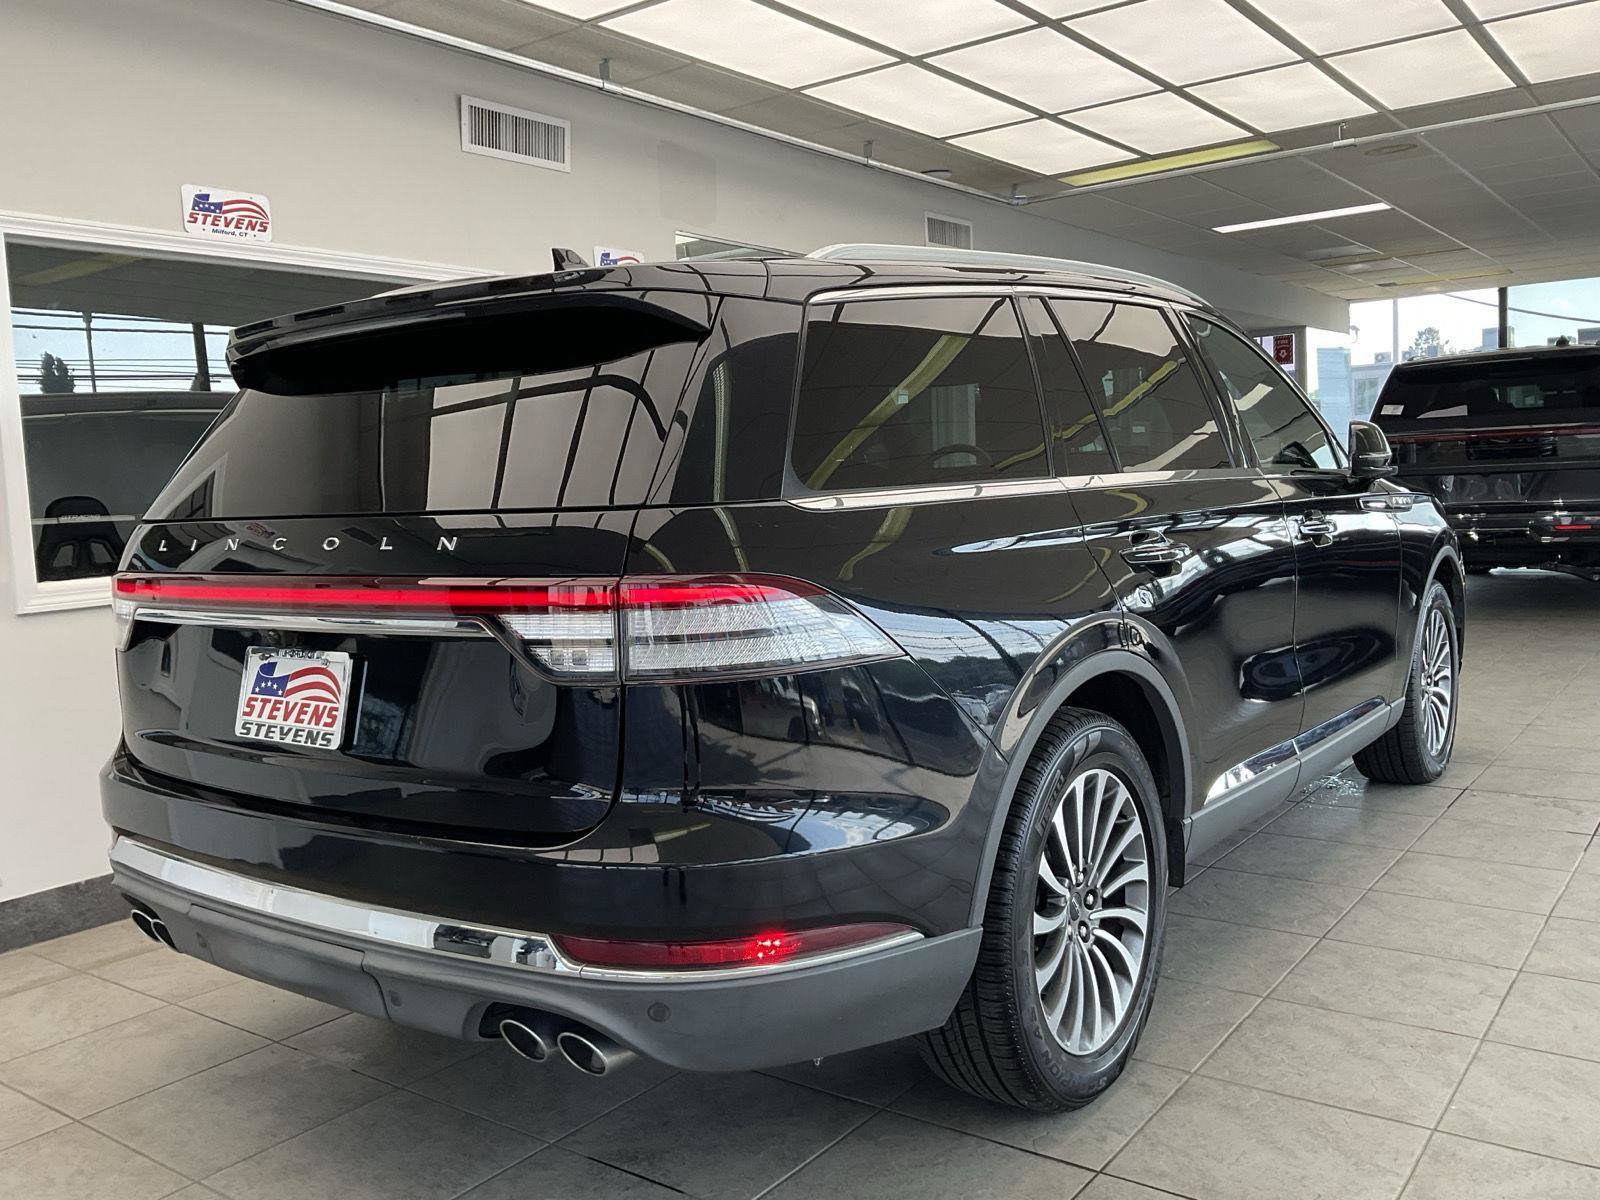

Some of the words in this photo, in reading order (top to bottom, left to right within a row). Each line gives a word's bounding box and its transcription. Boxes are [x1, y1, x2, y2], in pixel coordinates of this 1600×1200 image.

[187, 212, 269, 233] STEVENS
[211, 228, 237, 237] Milford,
[158, 536, 458, 552] LINCOLN
[242, 696, 340, 728] STEVENS
[239, 721, 336, 747] STEVENS
